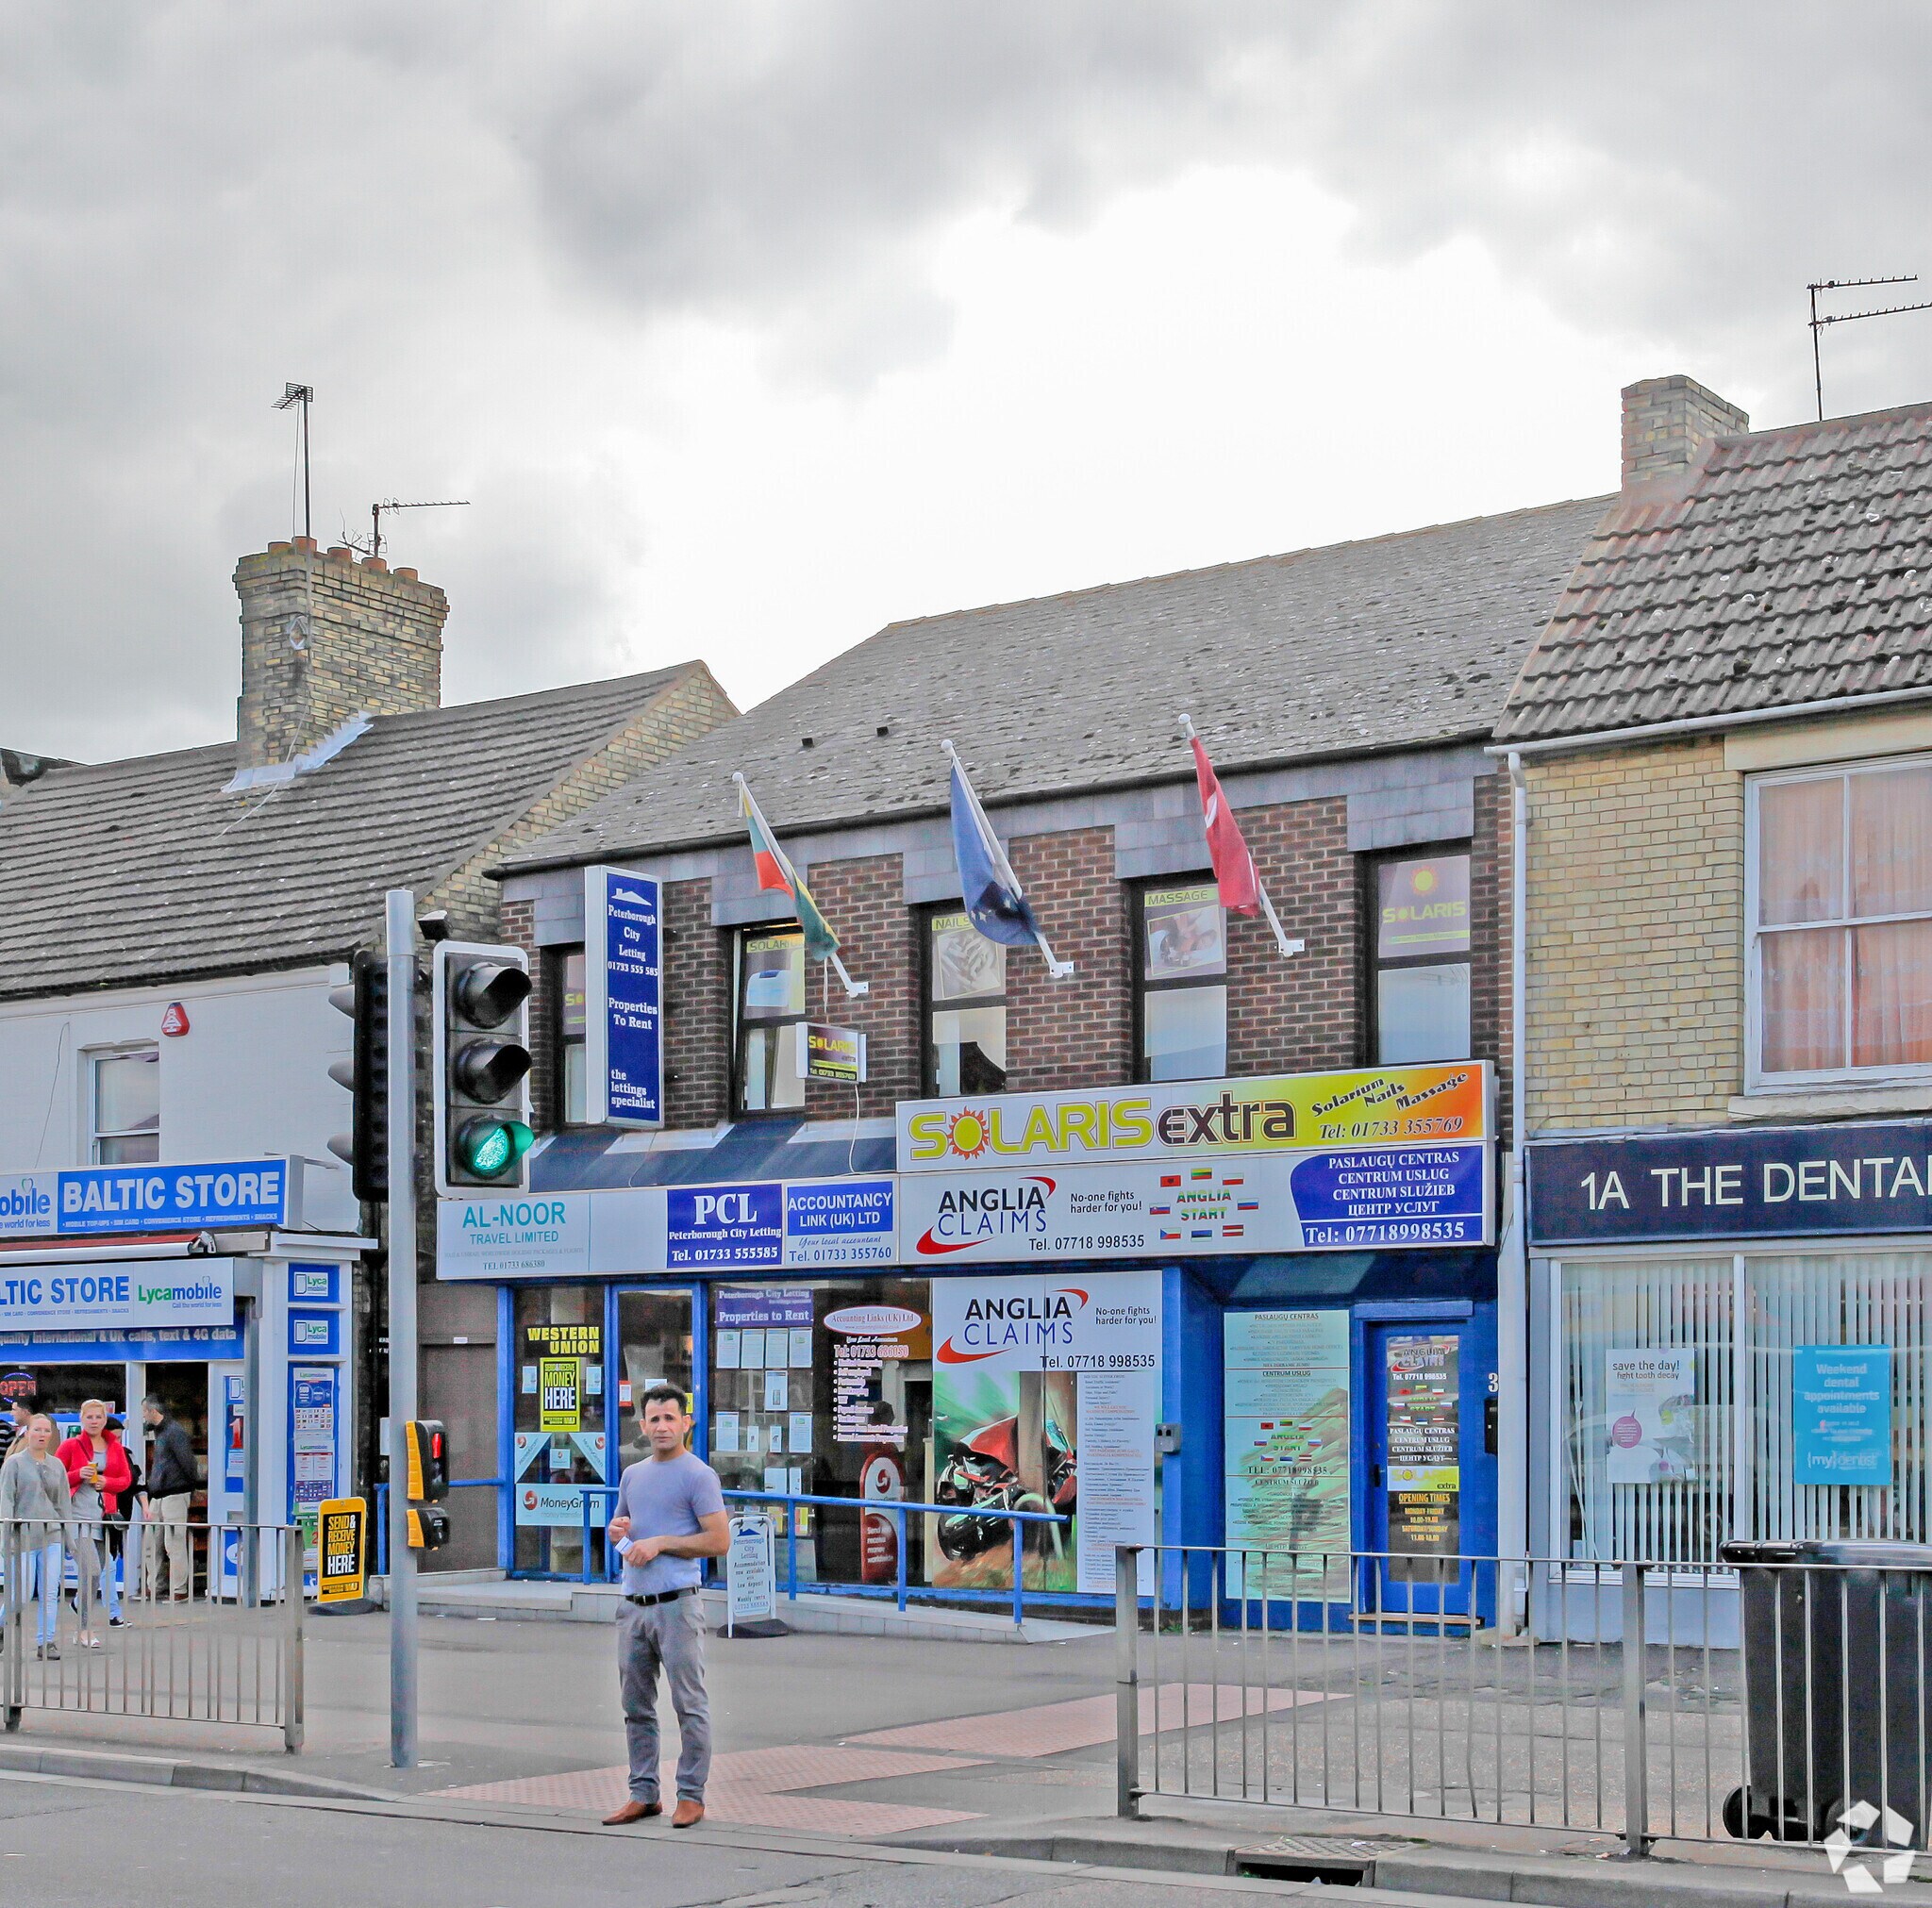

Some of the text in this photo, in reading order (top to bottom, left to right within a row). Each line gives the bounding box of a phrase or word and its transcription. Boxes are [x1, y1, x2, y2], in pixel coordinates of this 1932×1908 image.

[1148, 889, 1208, 905] MASSAGE
[608, 904, 657, 925] Peterborough
[1382, 901, 1466, 923] SOLARIS
[935, 916, 970, 930] NAILS
[624, 927, 641, 942] City
[619, 944, 646, 962] Letting
[608, 960, 658, 976] 01733 555 585
[608, 998, 658, 1015] Properties
[613, 1014, 652, 1030] To Rent
[808, 1035, 857, 1054] SOLARIS
[611, 1069, 626, 1081] the
[611, 1081, 647, 1096] lettings
[1363, 1083, 1406, 1107] Nails
[1395, 1073, 1469, 1111] Massage
[611, 1096, 656, 1110] specialist
[1311, 1078, 1384, 1118] Solarium
[908, 1090, 1297, 1160] SOLARIS extra
[1320, 1116, 1463, 1139] Tel: 01733 355769
[1328, 1151, 1459, 1170] PASLAUGŲ CENTRAS
[1338, 1170, 1402, 1185] CENTRUM
[1581, 1154, 1932, 1210] 1A THE DENTA
[63, 1171, 280, 1212] BALTIC STORE
[1071, 1190, 1134, 1203] No-one fights
[1176, 1188, 1231, 1203] ANGLIA
[1333, 1182, 1456, 1201] CENTRUM SLUŽIEB
[788, 1192, 892, 1211] ACCOUNTANCY
[938, 1186, 1047, 1213] ANGLIA
[462, 1202, 566, 1228] AL-NOOR
[693, 1193, 758, 1225] PCL
[1071, 1201, 1142, 1214] harder for you!
[1180, 1206, 1227, 1220] START
[1348, 1201, 1440, 1217] ЦЕНТР УСЛУГ
[36, 1219, 50, 1227] less
[800, 1211, 880, 1229] LINK (UK) LTD
[938, 1208, 1047, 1236] CLAIMS
[470, 1230, 558, 1245] TRAVEL LIMITED
[669, 1227, 782, 1240] Peterborough City Letting
[1306, 1221, 1464, 1244] Tel: 07718998535
[798, 1236, 882, 1249] Your local accountant
[1028, 1235, 1144, 1251] Tel. 07718 998535
[672, 1247, 777, 1261] Tel. 01733 555585
[789, 1247, 891, 1262] Tel. 01733 355760
[483, 1262, 498, 1270] TEL
[500, 1261, 519, 1269] 01733
[308, 1276, 327, 1286] Lyca
[51, 1276, 129, 1303] STORE
[138, 1282, 222, 1304] Lycamobile
[719, 1288, 809, 1300] Peterborough City Letting
[964, 1297, 1073, 1320] ANGLIA
[1095, 1306, 1150, 1317] No-one fights
[719, 1310, 809, 1324] Properties to Rent
[832, 1315, 865, 1323] Accounting
[1095, 1316, 1157, 1326] harder for you!
[158, 1329, 180, 1341] text
[193, 1328, 208, 1340] 4G
[211, 1328, 237, 1340] data
[308, 1324, 327, 1334] Lyca
[527, 1326, 600, 1340] WESTERN
[964, 1321, 1073, 1345] CLAIMS
[550, 1340, 600, 1354] UNION
[1040, 1354, 1155, 1369] Tel. 07718 998535
[1612, 1360, 1679, 1372] save the day!
[1816, 1363, 1867, 1375] Weekend
[544, 1371, 575, 1387] MONEY
[1488, 1372, 1499, 1392] 3
[1617, 1371, 1633, 1381] fight
[1657, 1371, 1679, 1380] decay
[1824, 1377, 1859, 1387] dental
[544, 1387, 575, 1409] HERE
[1804, 1391, 1880, 1402] appointments
[1817, 1403, 1867, 1414] available
[540, 1497, 600, 1511] MoneyGrm
[1399, 1493, 1450, 1502] OPENING TIMES
[327, 1514, 357, 1530] SEND &
[327, 1529, 356, 1542] RECEIVE
[327, 1541, 356, 1556] MONEY
[326, 1554, 356, 1575] HERE
